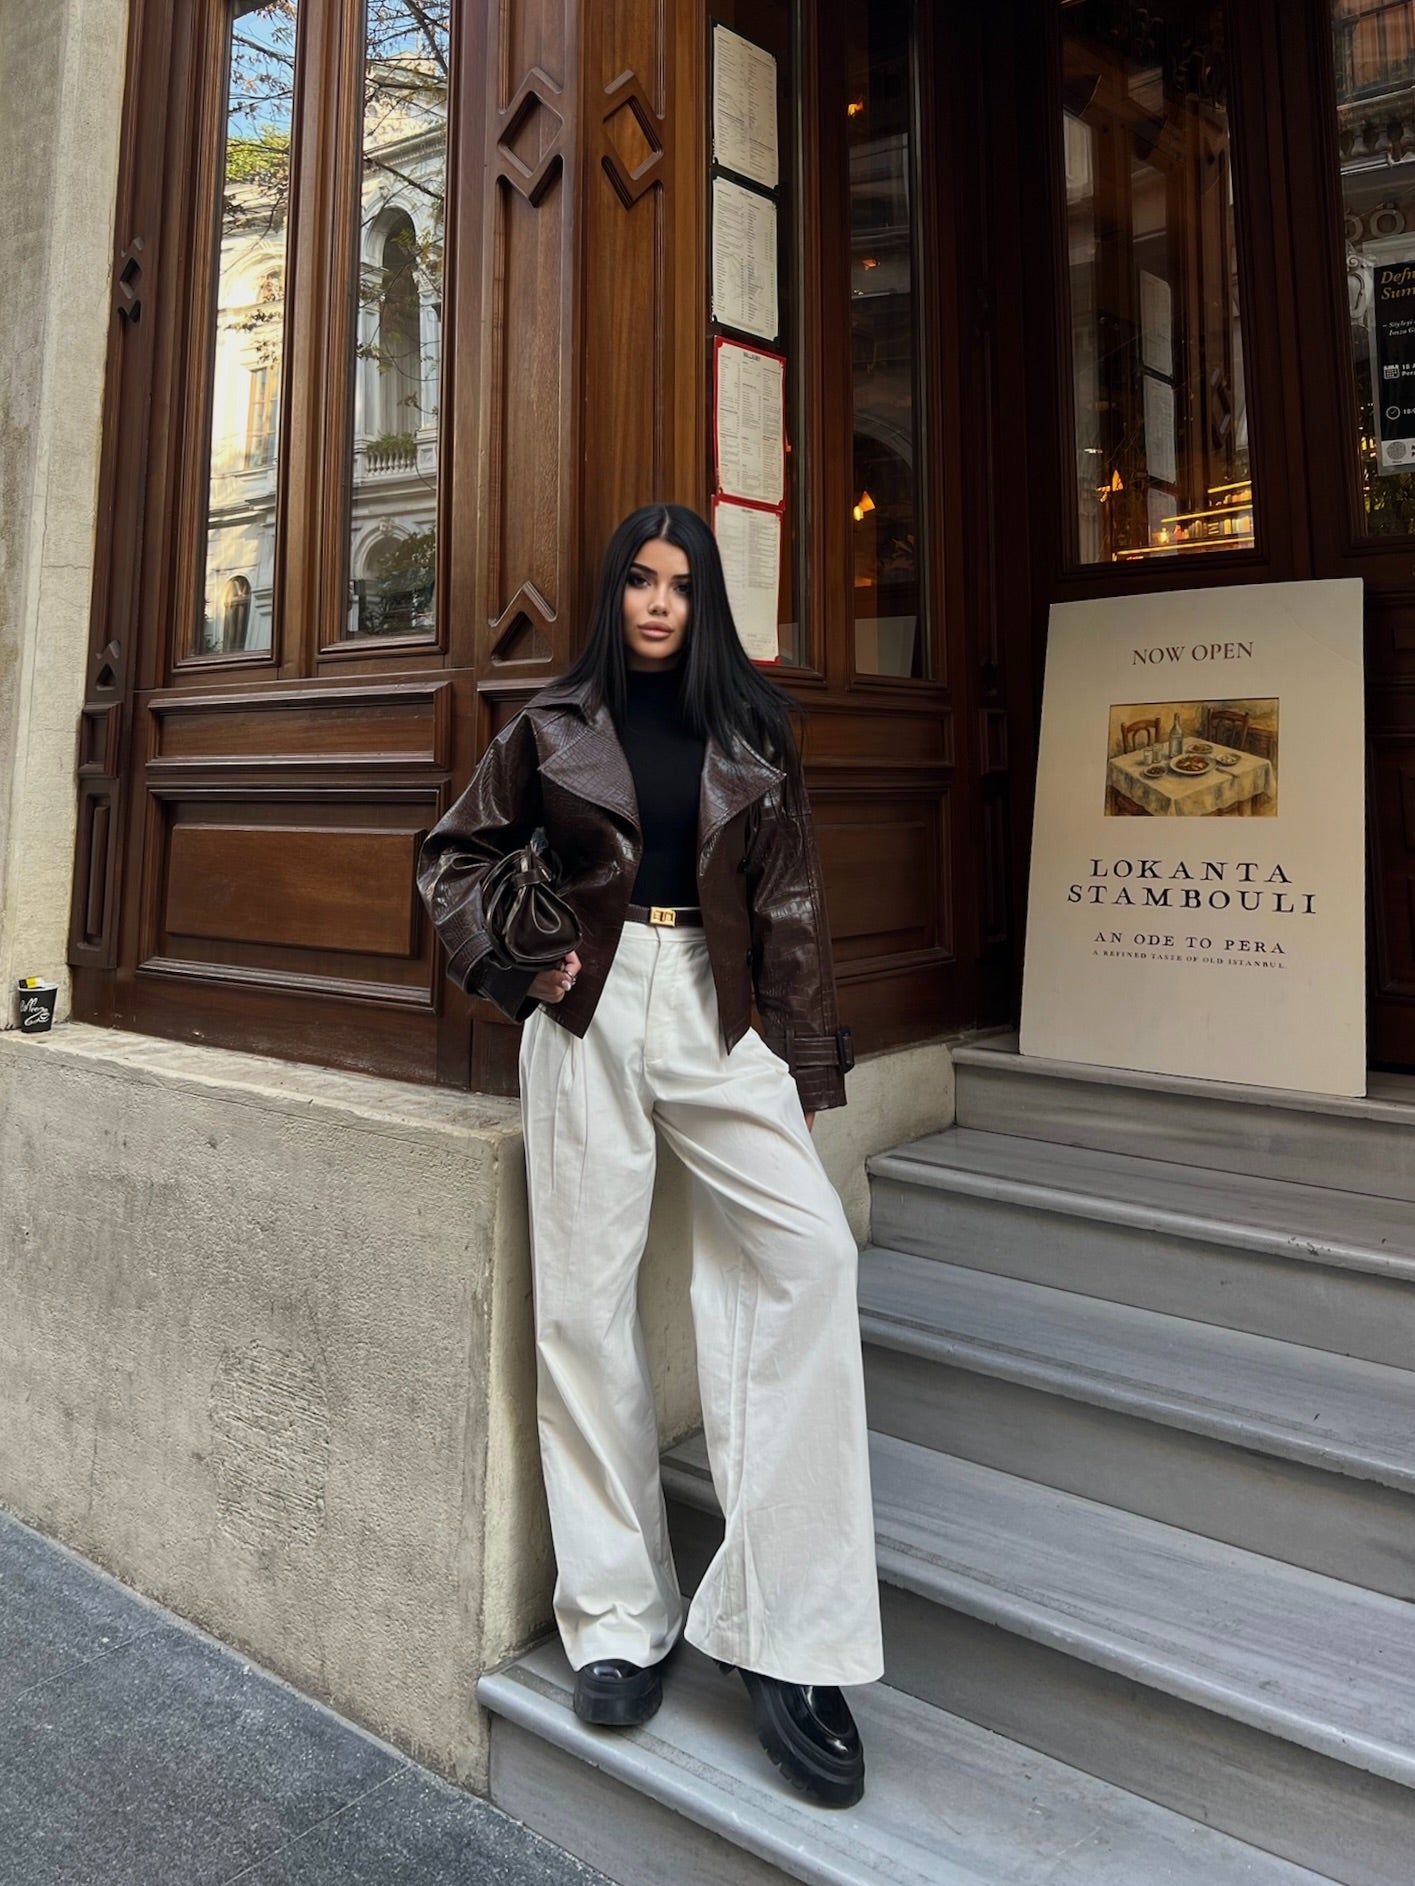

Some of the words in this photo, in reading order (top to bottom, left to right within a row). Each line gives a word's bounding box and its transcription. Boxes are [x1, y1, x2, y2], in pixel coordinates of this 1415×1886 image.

[1132, 645, 1185, 666] NOW
[1191, 641, 1254, 662] OPEN
[1089, 859, 1293, 883] LOKANTA
[1067, 884, 1316, 915] STAMBOULI
[1093, 931, 1123, 944] AN
[1133, 933, 1175, 947] ODE
[1185, 936, 1212, 950] TO
[1224, 939, 1285, 954] PERA
[1103, 950, 1147, 959] REFINED
[1151, 953, 1182, 962] TASTE
[1186, 955, 1198, 963] OF
[1202, 957, 1224, 965] OLD
[1228, 959, 1286, 969] ISTANBUL
